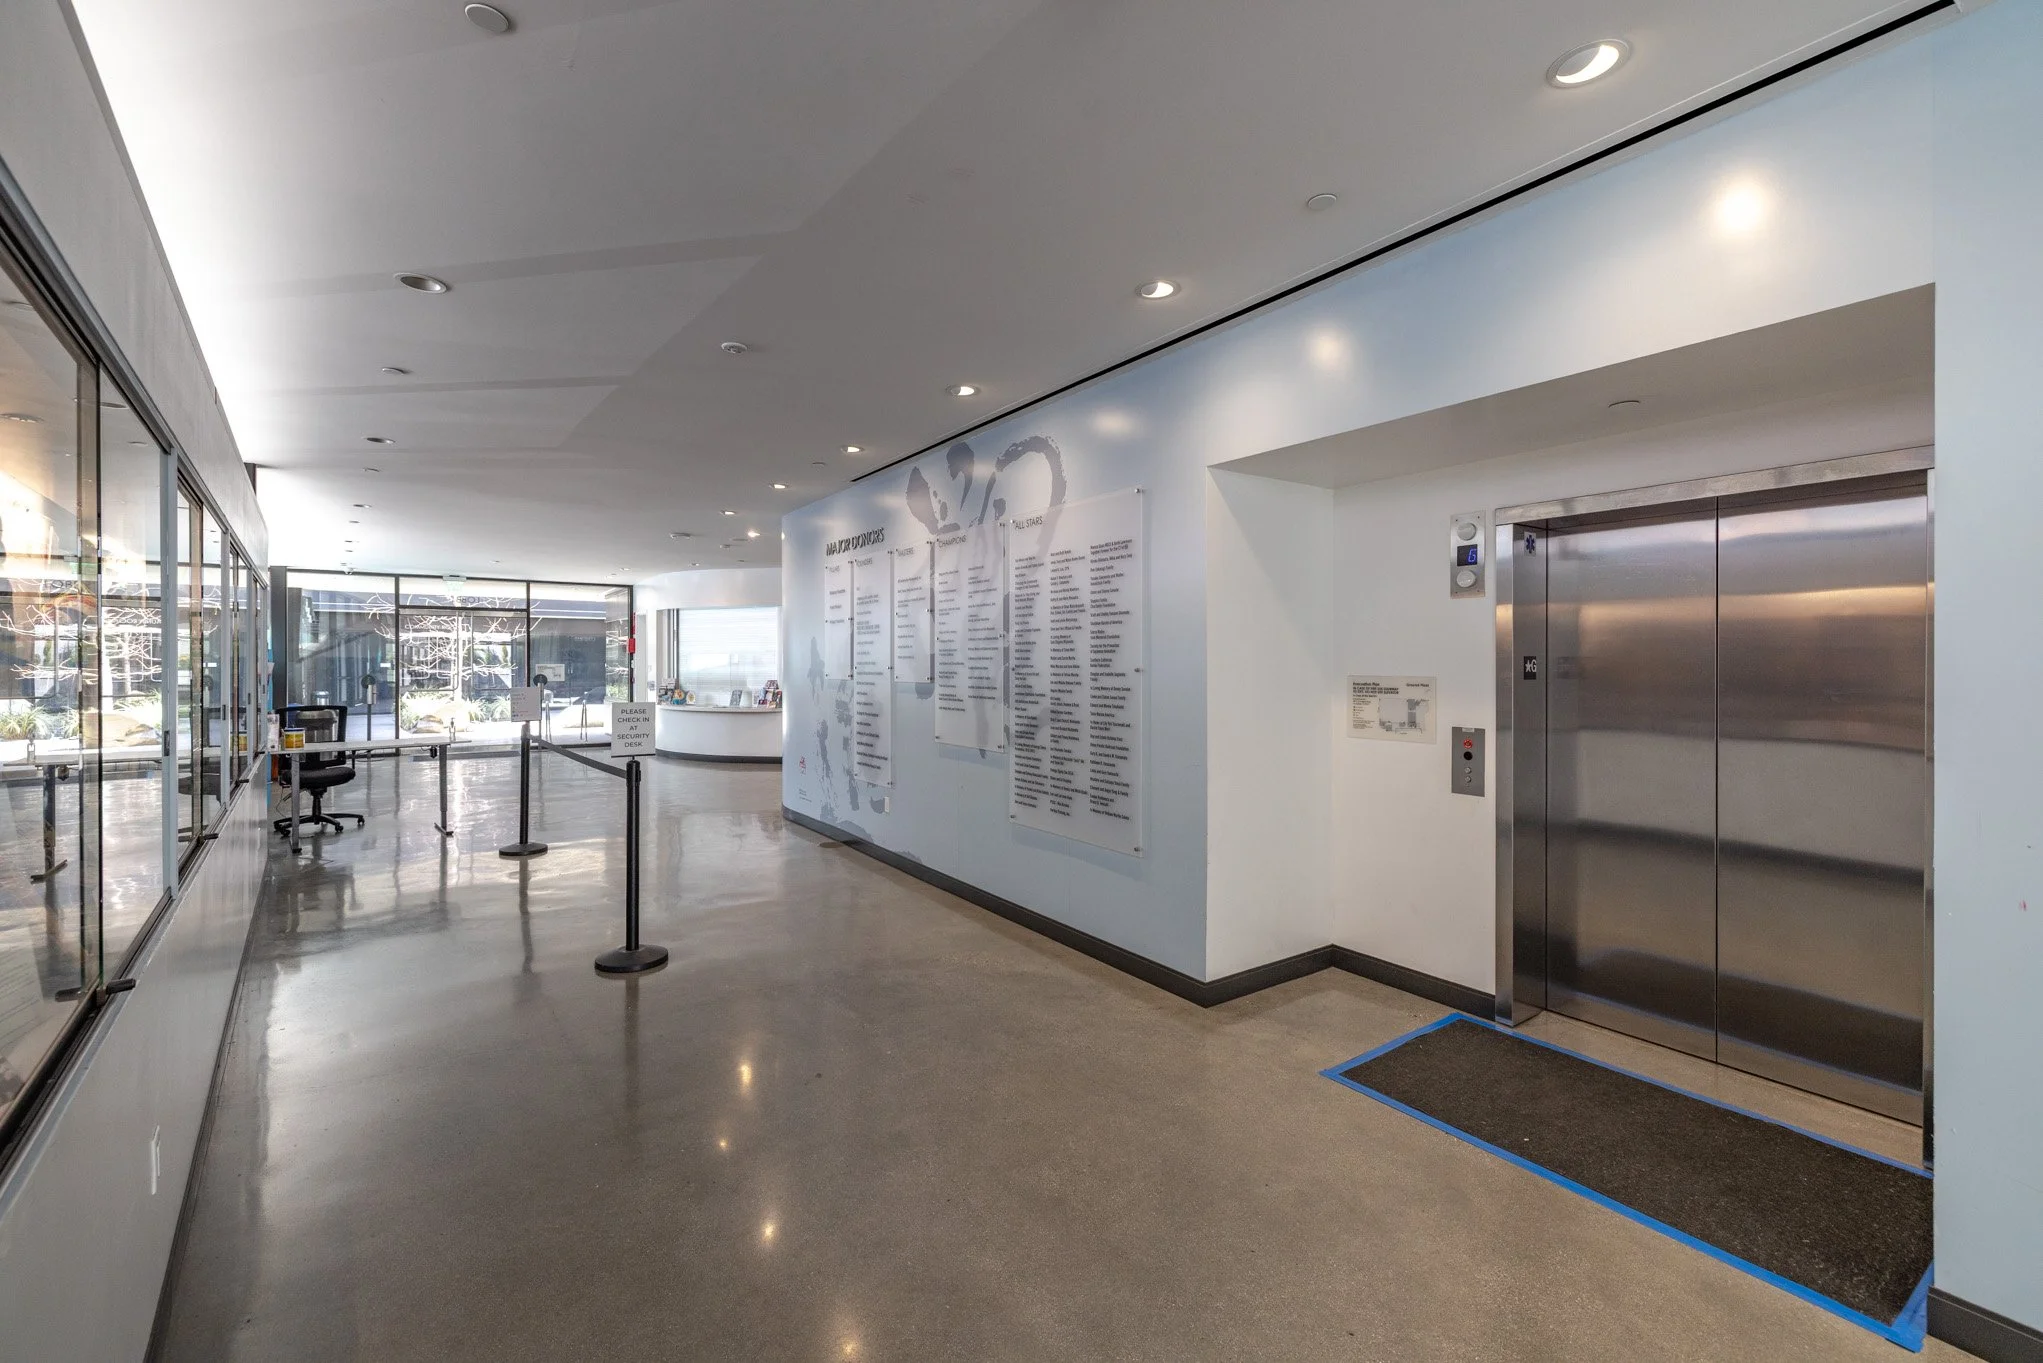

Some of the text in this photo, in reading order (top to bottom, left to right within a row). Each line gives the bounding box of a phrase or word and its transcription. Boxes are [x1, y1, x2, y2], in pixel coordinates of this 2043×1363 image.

[1015, 516, 1043, 530] ALL STARS
[826, 527, 884, 556] MAJOR DONORS
[938, 534, 967, 548] CHAMPIONS
